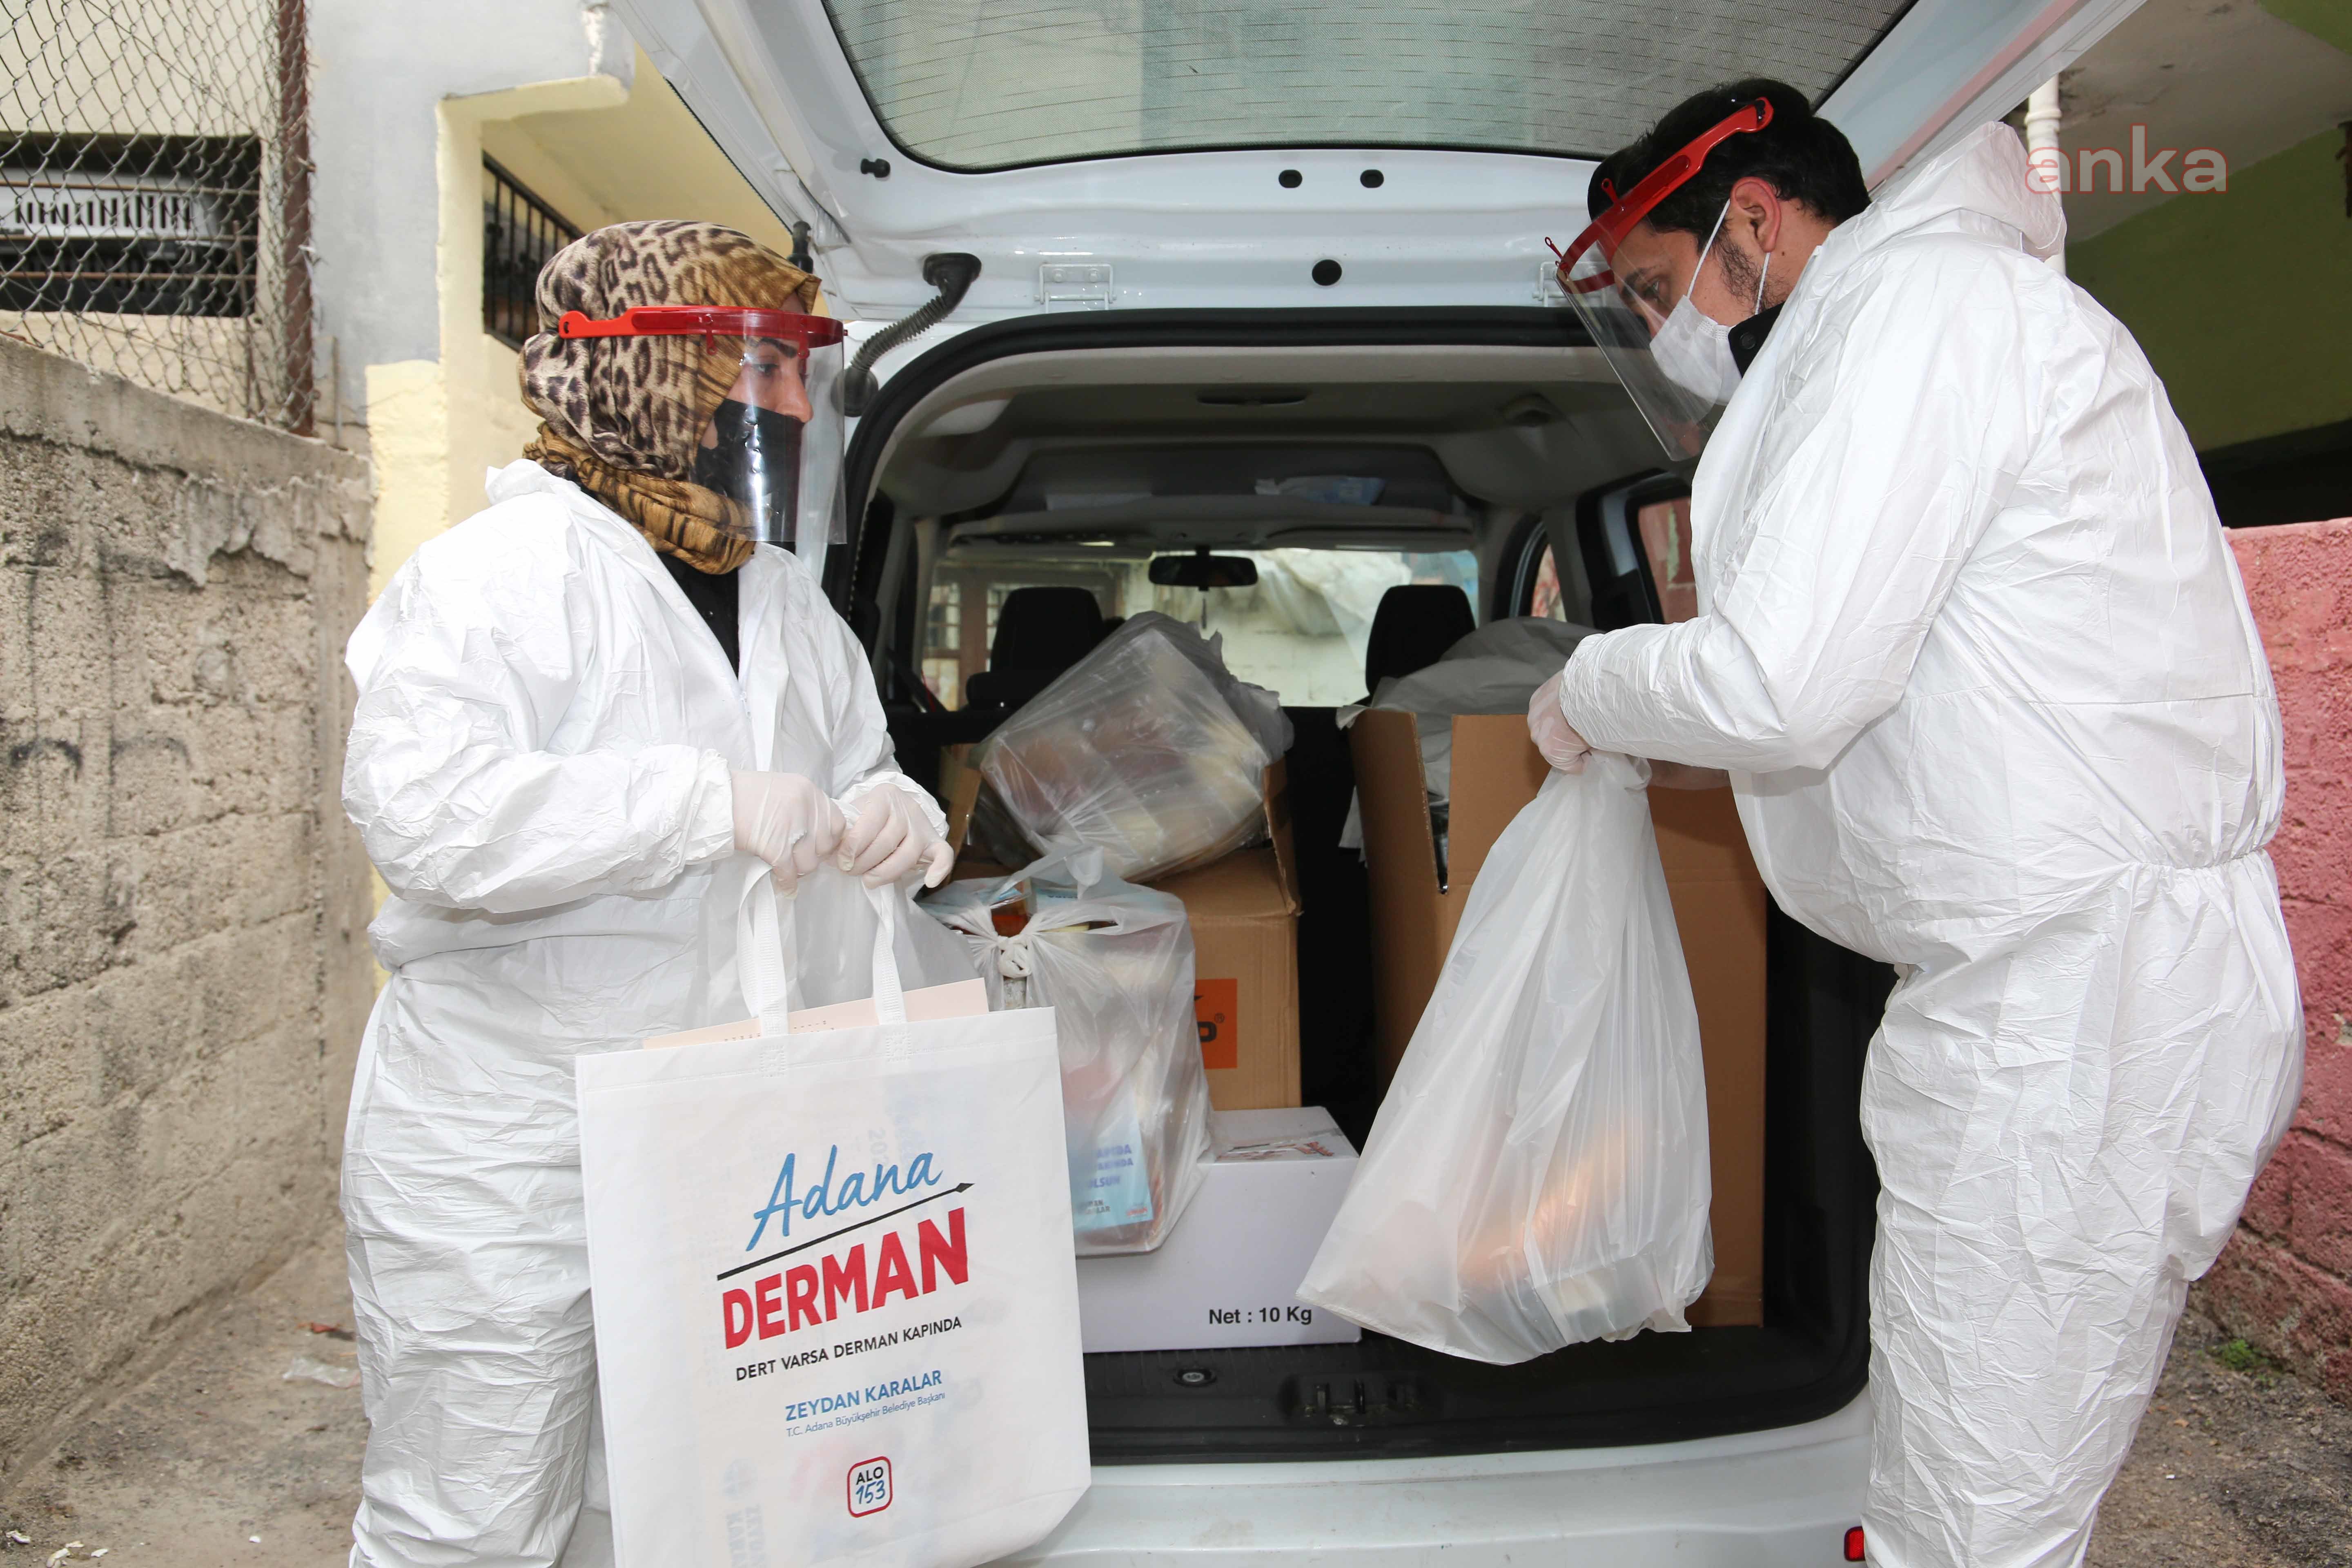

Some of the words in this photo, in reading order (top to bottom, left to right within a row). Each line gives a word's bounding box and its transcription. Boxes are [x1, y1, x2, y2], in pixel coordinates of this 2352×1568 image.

[746, 1144, 943, 1251] Adana
[723, 1207, 969, 1350] DERMAN
[1209, 1309, 1241, 1324] Net
[1259, 1307, 1280, 1322] 10
[1287, 1306, 1312, 1325] Kg
[736, 1359, 776, 1381] DERT
[781, 1348, 829, 1370] VARSA
[834, 1331, 898, 1358] DERMAN
[903, 1316, 962, 1342] KAPINDA
[785, 1390, 860, 1421] ZEYDAN
[865, 1370, 942, 1403] KARALAR
[786, 1426, 803, 1437] T.C.
[805, 1421, 833, 1433] Adana
[836, 1408, 880, 1427] Büyükşehir
[882, 1400, 915, 1415] Belediye
[918, 1392, 945, 1405] Başkanı
[855, 1466, 884, 1485] ALO
[855, 1479, 886, 1504] 153
